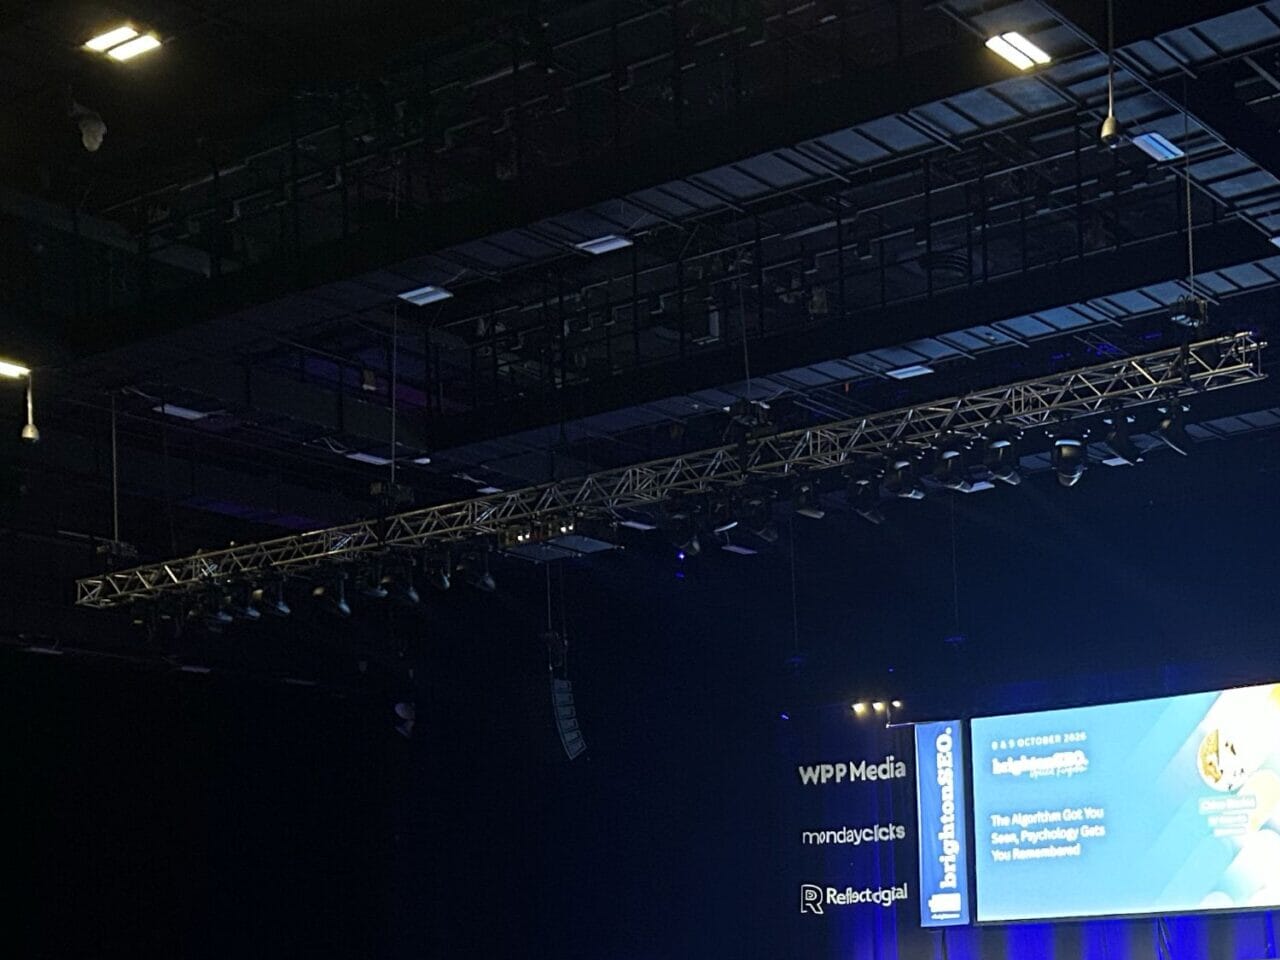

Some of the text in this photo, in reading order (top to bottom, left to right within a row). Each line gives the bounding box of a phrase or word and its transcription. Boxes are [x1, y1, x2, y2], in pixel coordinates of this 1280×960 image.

[1017, 734, 1061, 748] OCTOBER
[799, 755, 906, 785] WPP Media
[991, 806, 1104, 827] The Algorithm Got You
[1020, 826, 1079, 844] Psychology
[991, 849, 1011, 861] You
